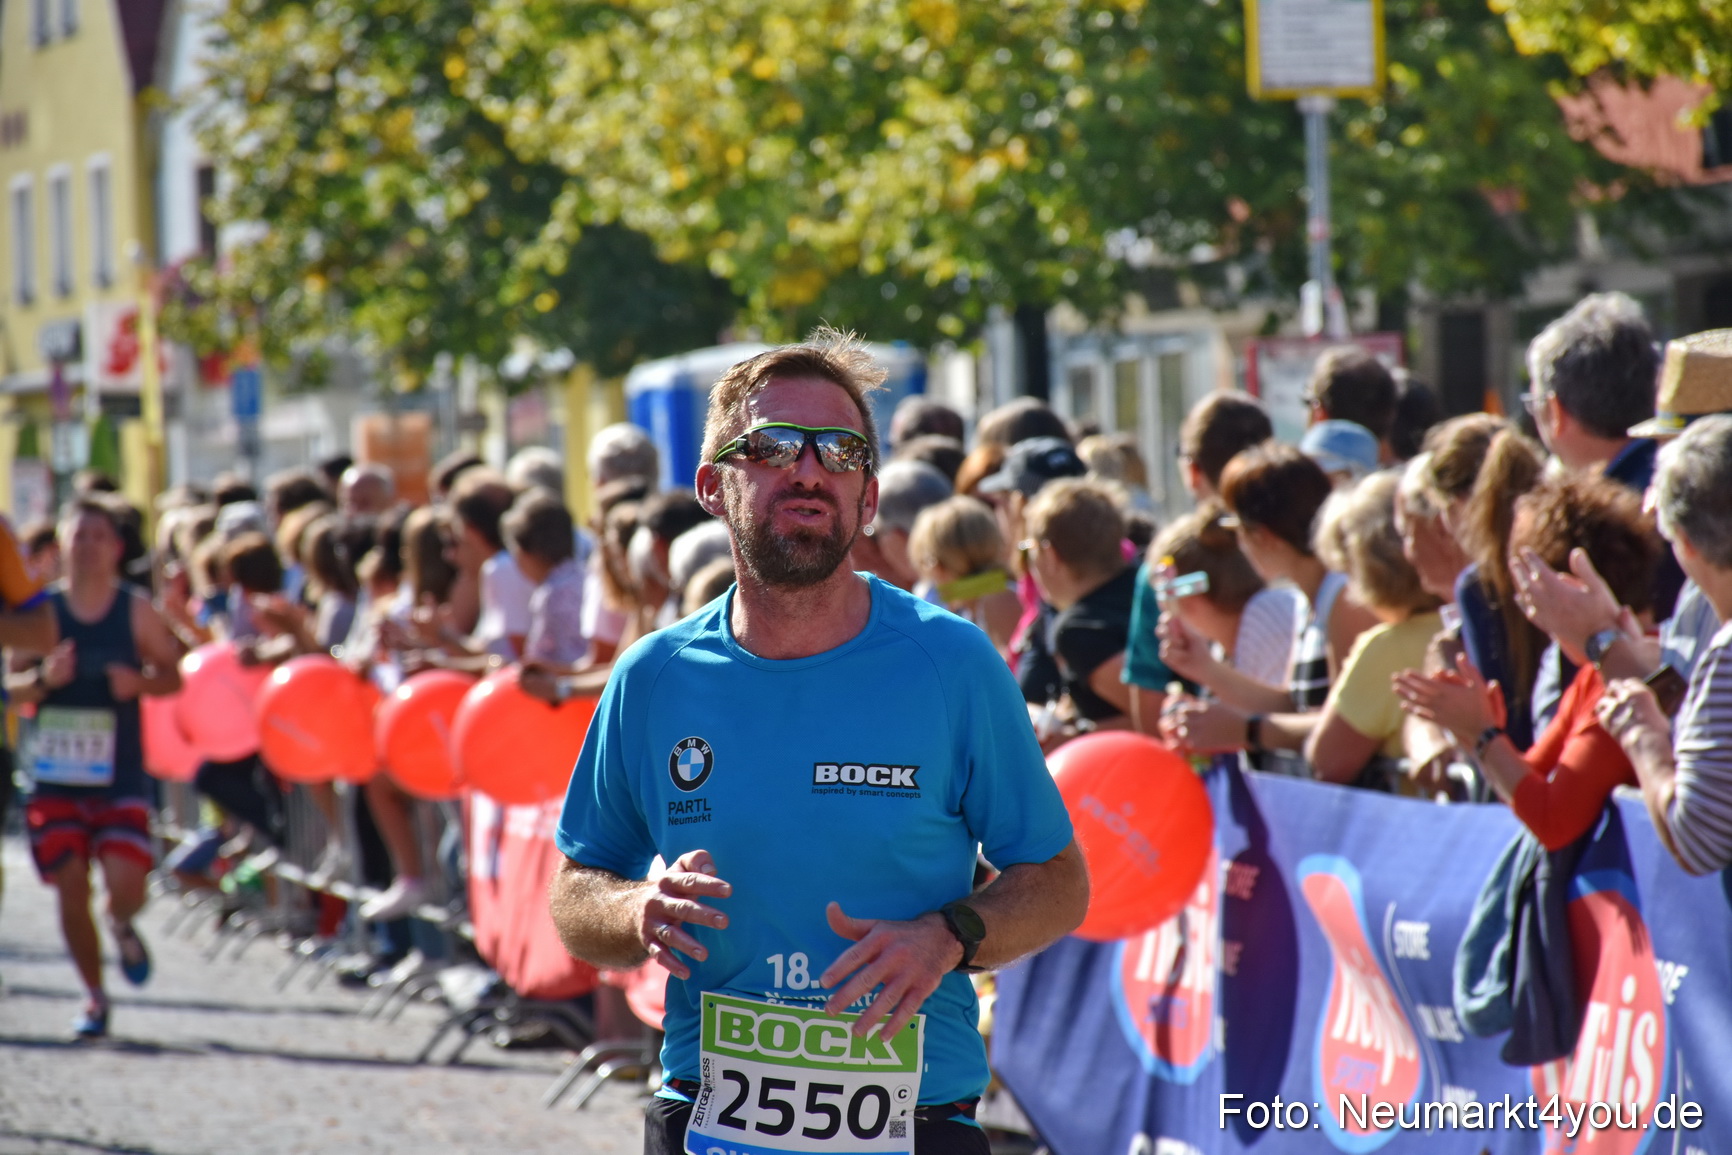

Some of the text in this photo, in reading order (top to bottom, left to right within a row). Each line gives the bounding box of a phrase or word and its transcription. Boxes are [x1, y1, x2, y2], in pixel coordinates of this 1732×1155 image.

[673, 738, 710, 757] BMW
[814, 763, 918, 788] BOCK
[811, 786, 921, 799] inspired by smart concepts
[668, 798, 712, 815] PARTL
[668, 813, 712, 826] Neumarkt
[766, 952, 820, 990] 18.
[718, 1008, 897, 1062] BOCK
[717, 1069, 892, 1140] 2550
